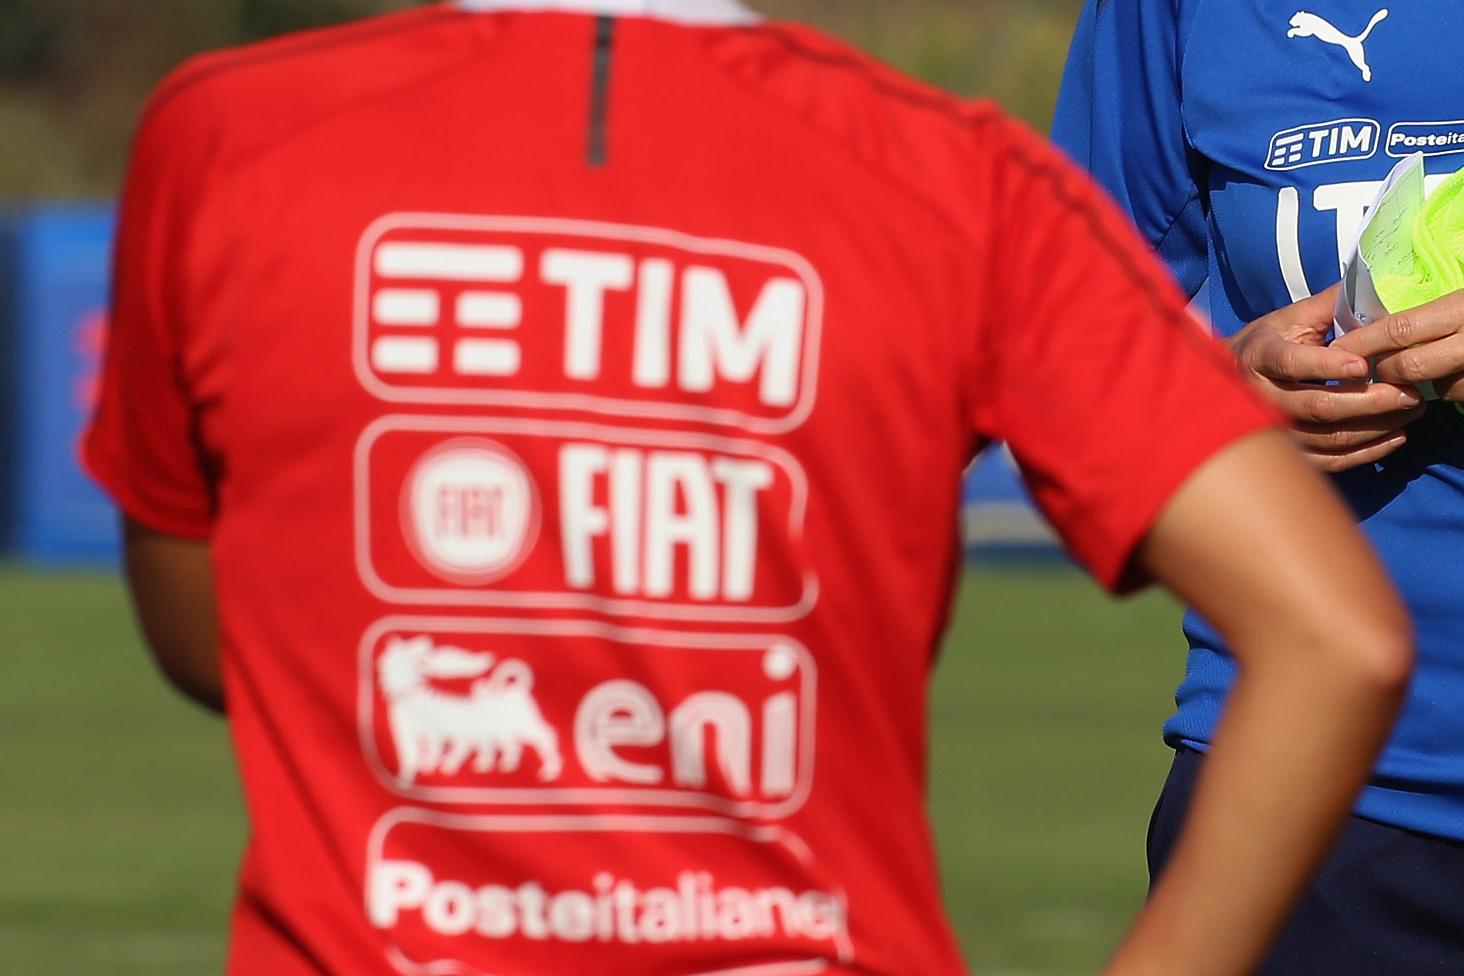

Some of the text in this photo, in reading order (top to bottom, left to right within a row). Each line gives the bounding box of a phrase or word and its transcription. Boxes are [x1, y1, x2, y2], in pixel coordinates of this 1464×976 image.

[1309, 126, 1371, 158] TIM
[541, 248, 804, 406] TIM
[559, 444, 772, 600] FIAT
[574, 643, 798, 797] eni
